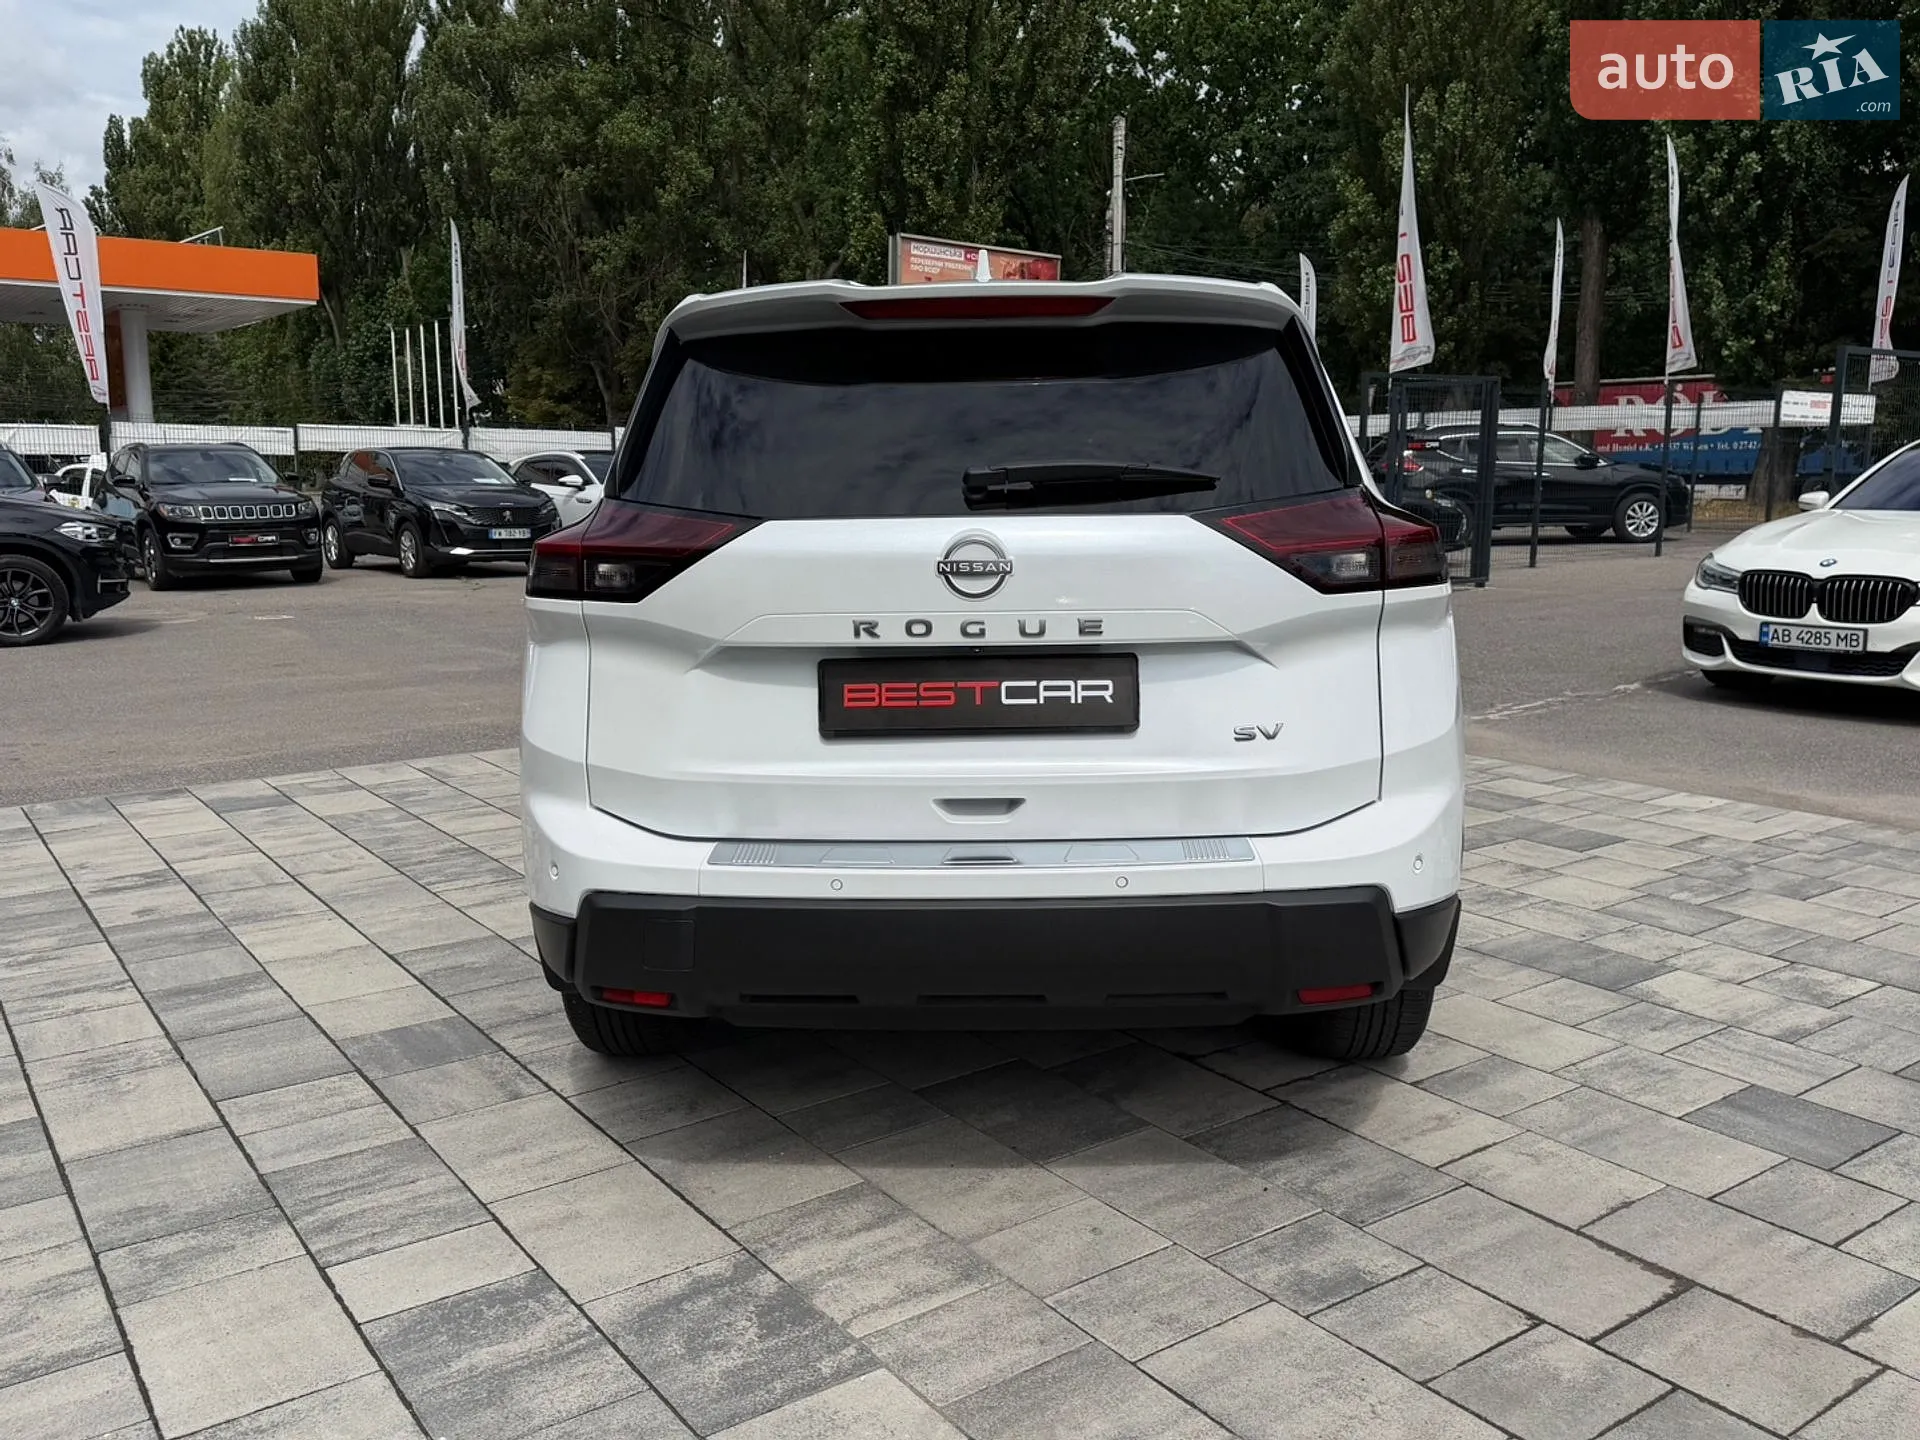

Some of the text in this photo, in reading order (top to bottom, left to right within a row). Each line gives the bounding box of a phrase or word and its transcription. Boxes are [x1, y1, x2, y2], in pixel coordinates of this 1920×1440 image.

[938, 560, 1013, 574] NISSAN
[852, 618, 1105, 640] ROGUE
[1770, 628, 1860, 648] AB 4285 MB
[843, 679, 1115, 709] BESTCAR
[1232, 721, 1285, 743] SV
